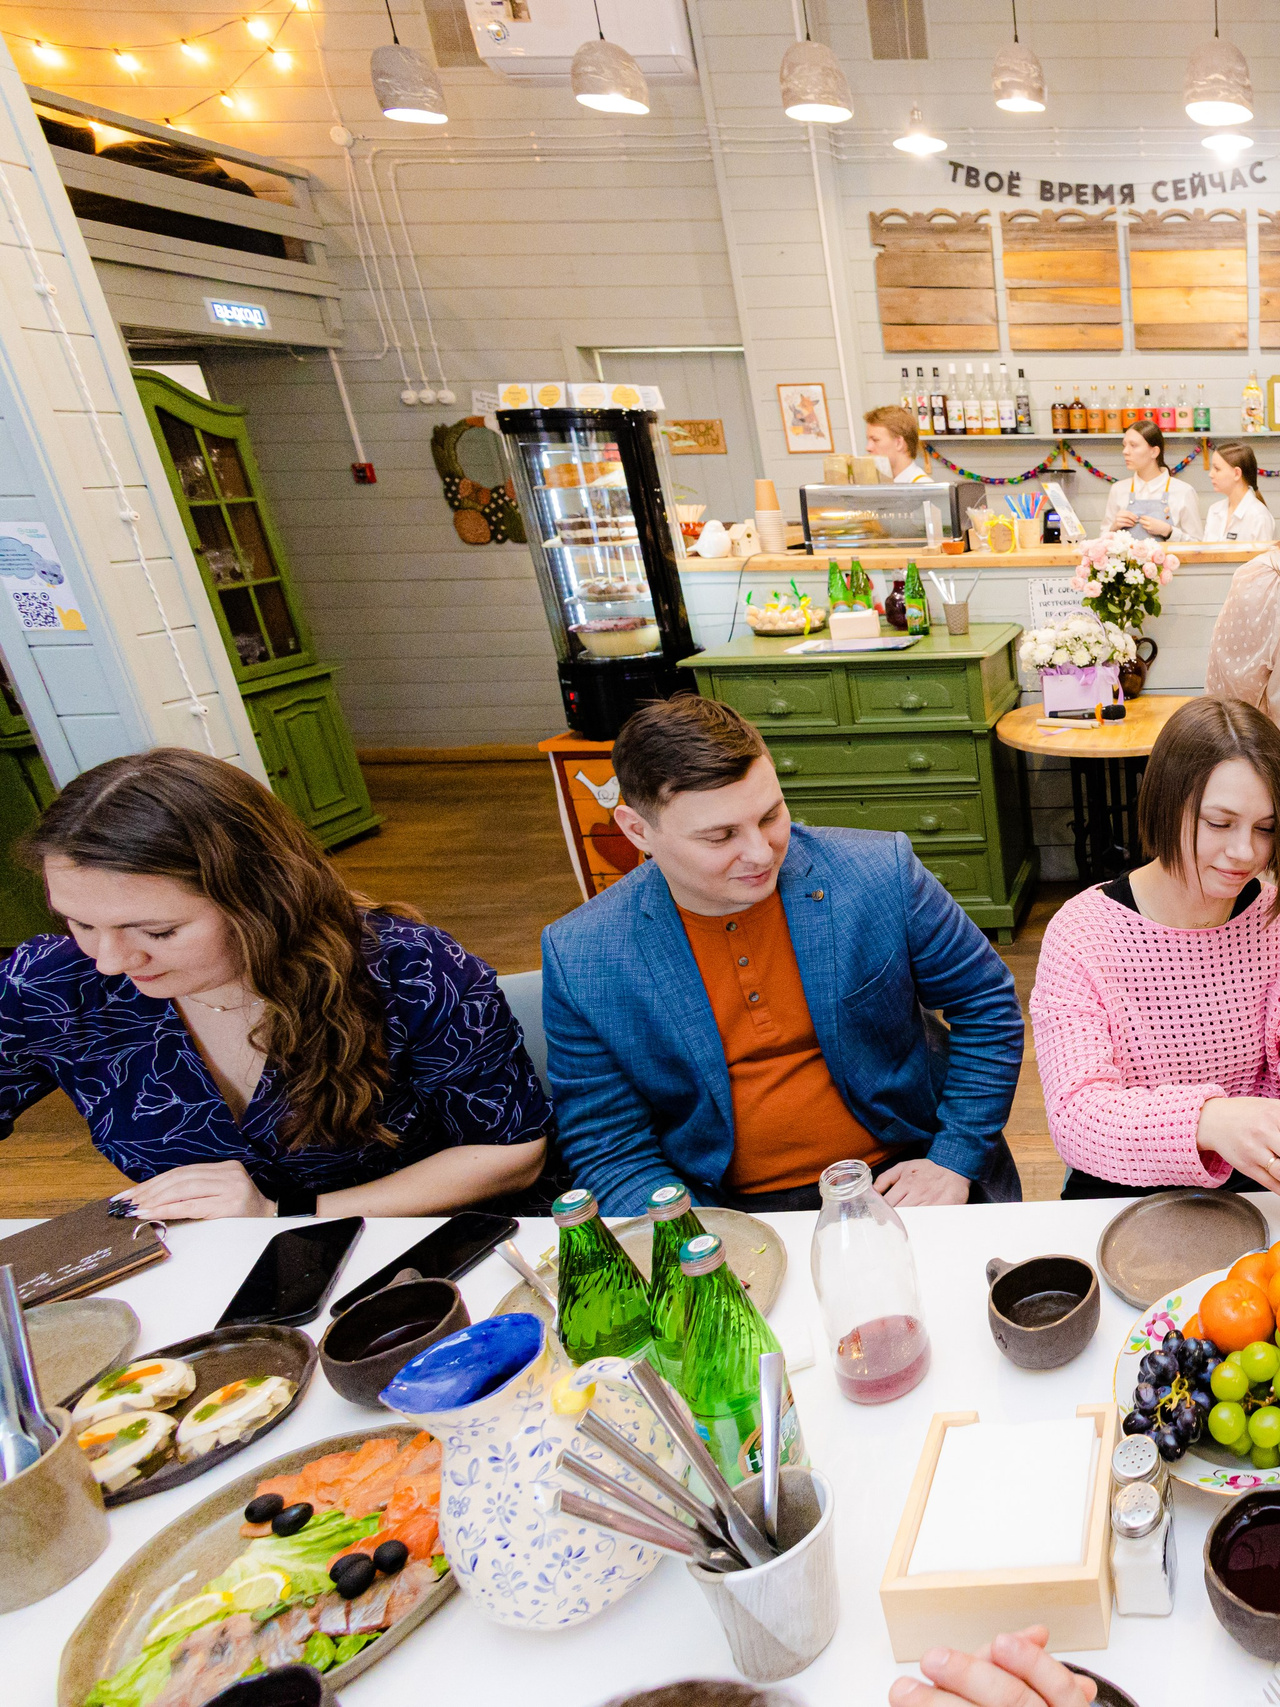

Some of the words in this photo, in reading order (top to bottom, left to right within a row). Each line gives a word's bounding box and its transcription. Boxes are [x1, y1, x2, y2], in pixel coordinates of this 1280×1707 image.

[949, 161, 1021, 197] ТВОЁ
[1039, 180, 1136, 206] ВРЕМЯ
[1151, 161, 1267, 203] СЕЙЧАС
[213, 303, 265, 325] ВЫХОД
